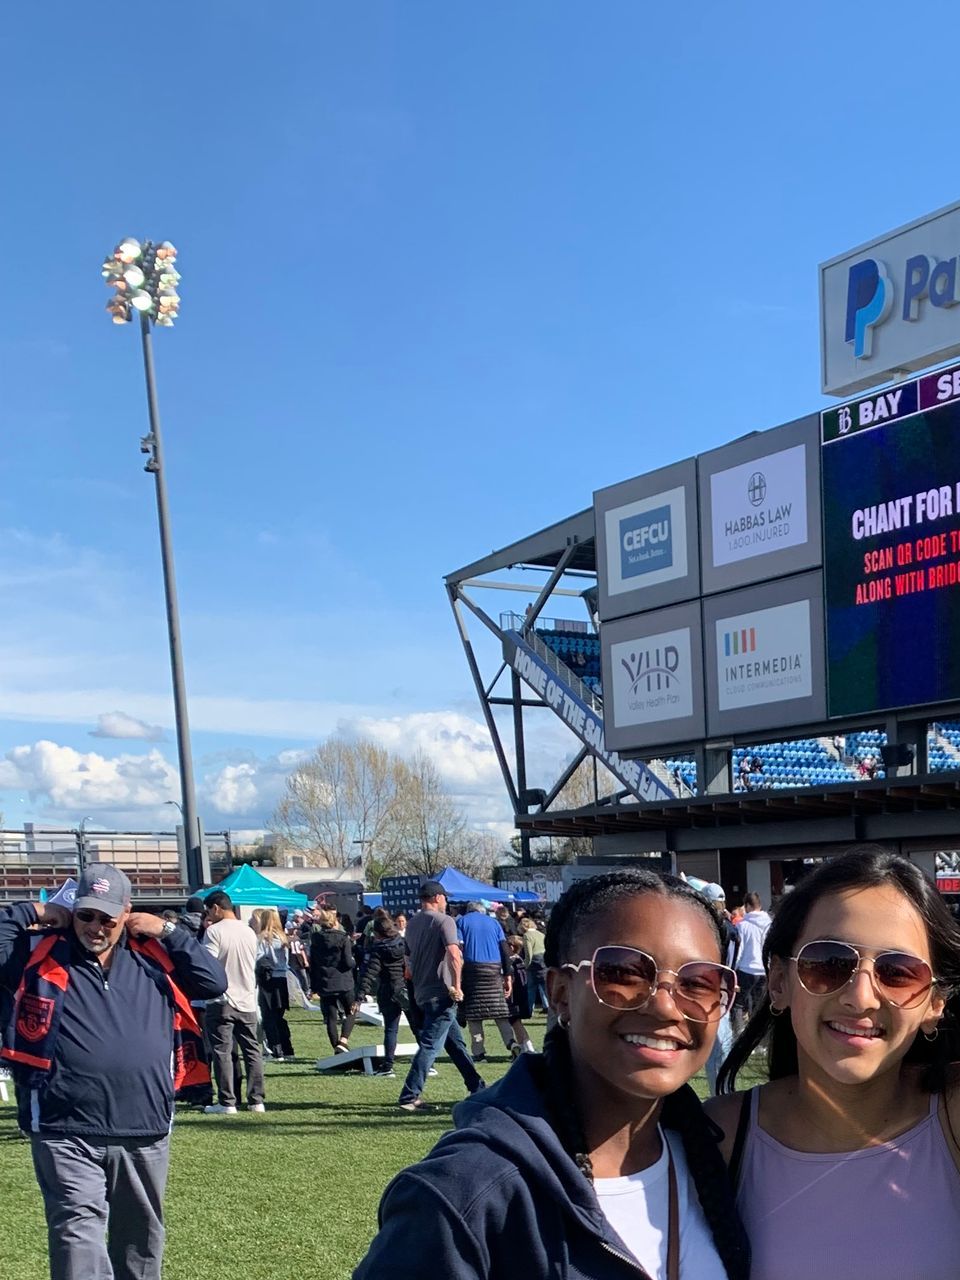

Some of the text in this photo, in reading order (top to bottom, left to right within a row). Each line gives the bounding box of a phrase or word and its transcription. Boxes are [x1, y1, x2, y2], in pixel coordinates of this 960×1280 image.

[859, 390, 902, 425] BAY
[725, 502, 792, 536] HABBAS LAW
[852, 496, 912, 540] CHANT
[916, 485, 953, 523] FOR
[624, 520, 669, 551] CEFCU
[864, 547, 893, 574] SCAN
[897, 543, 912, 566] QR
[916, 533, 947, 561] CODE
[856, 577, 891, 605] ALONG
[895, 570, 924, 596] WITH
[725, 654, 801, 682] INTERMEDIA
[514, 646, 548, 694] HOME
[545, 679, 564, 709] OF
[561, 696, 587, 735] THE
